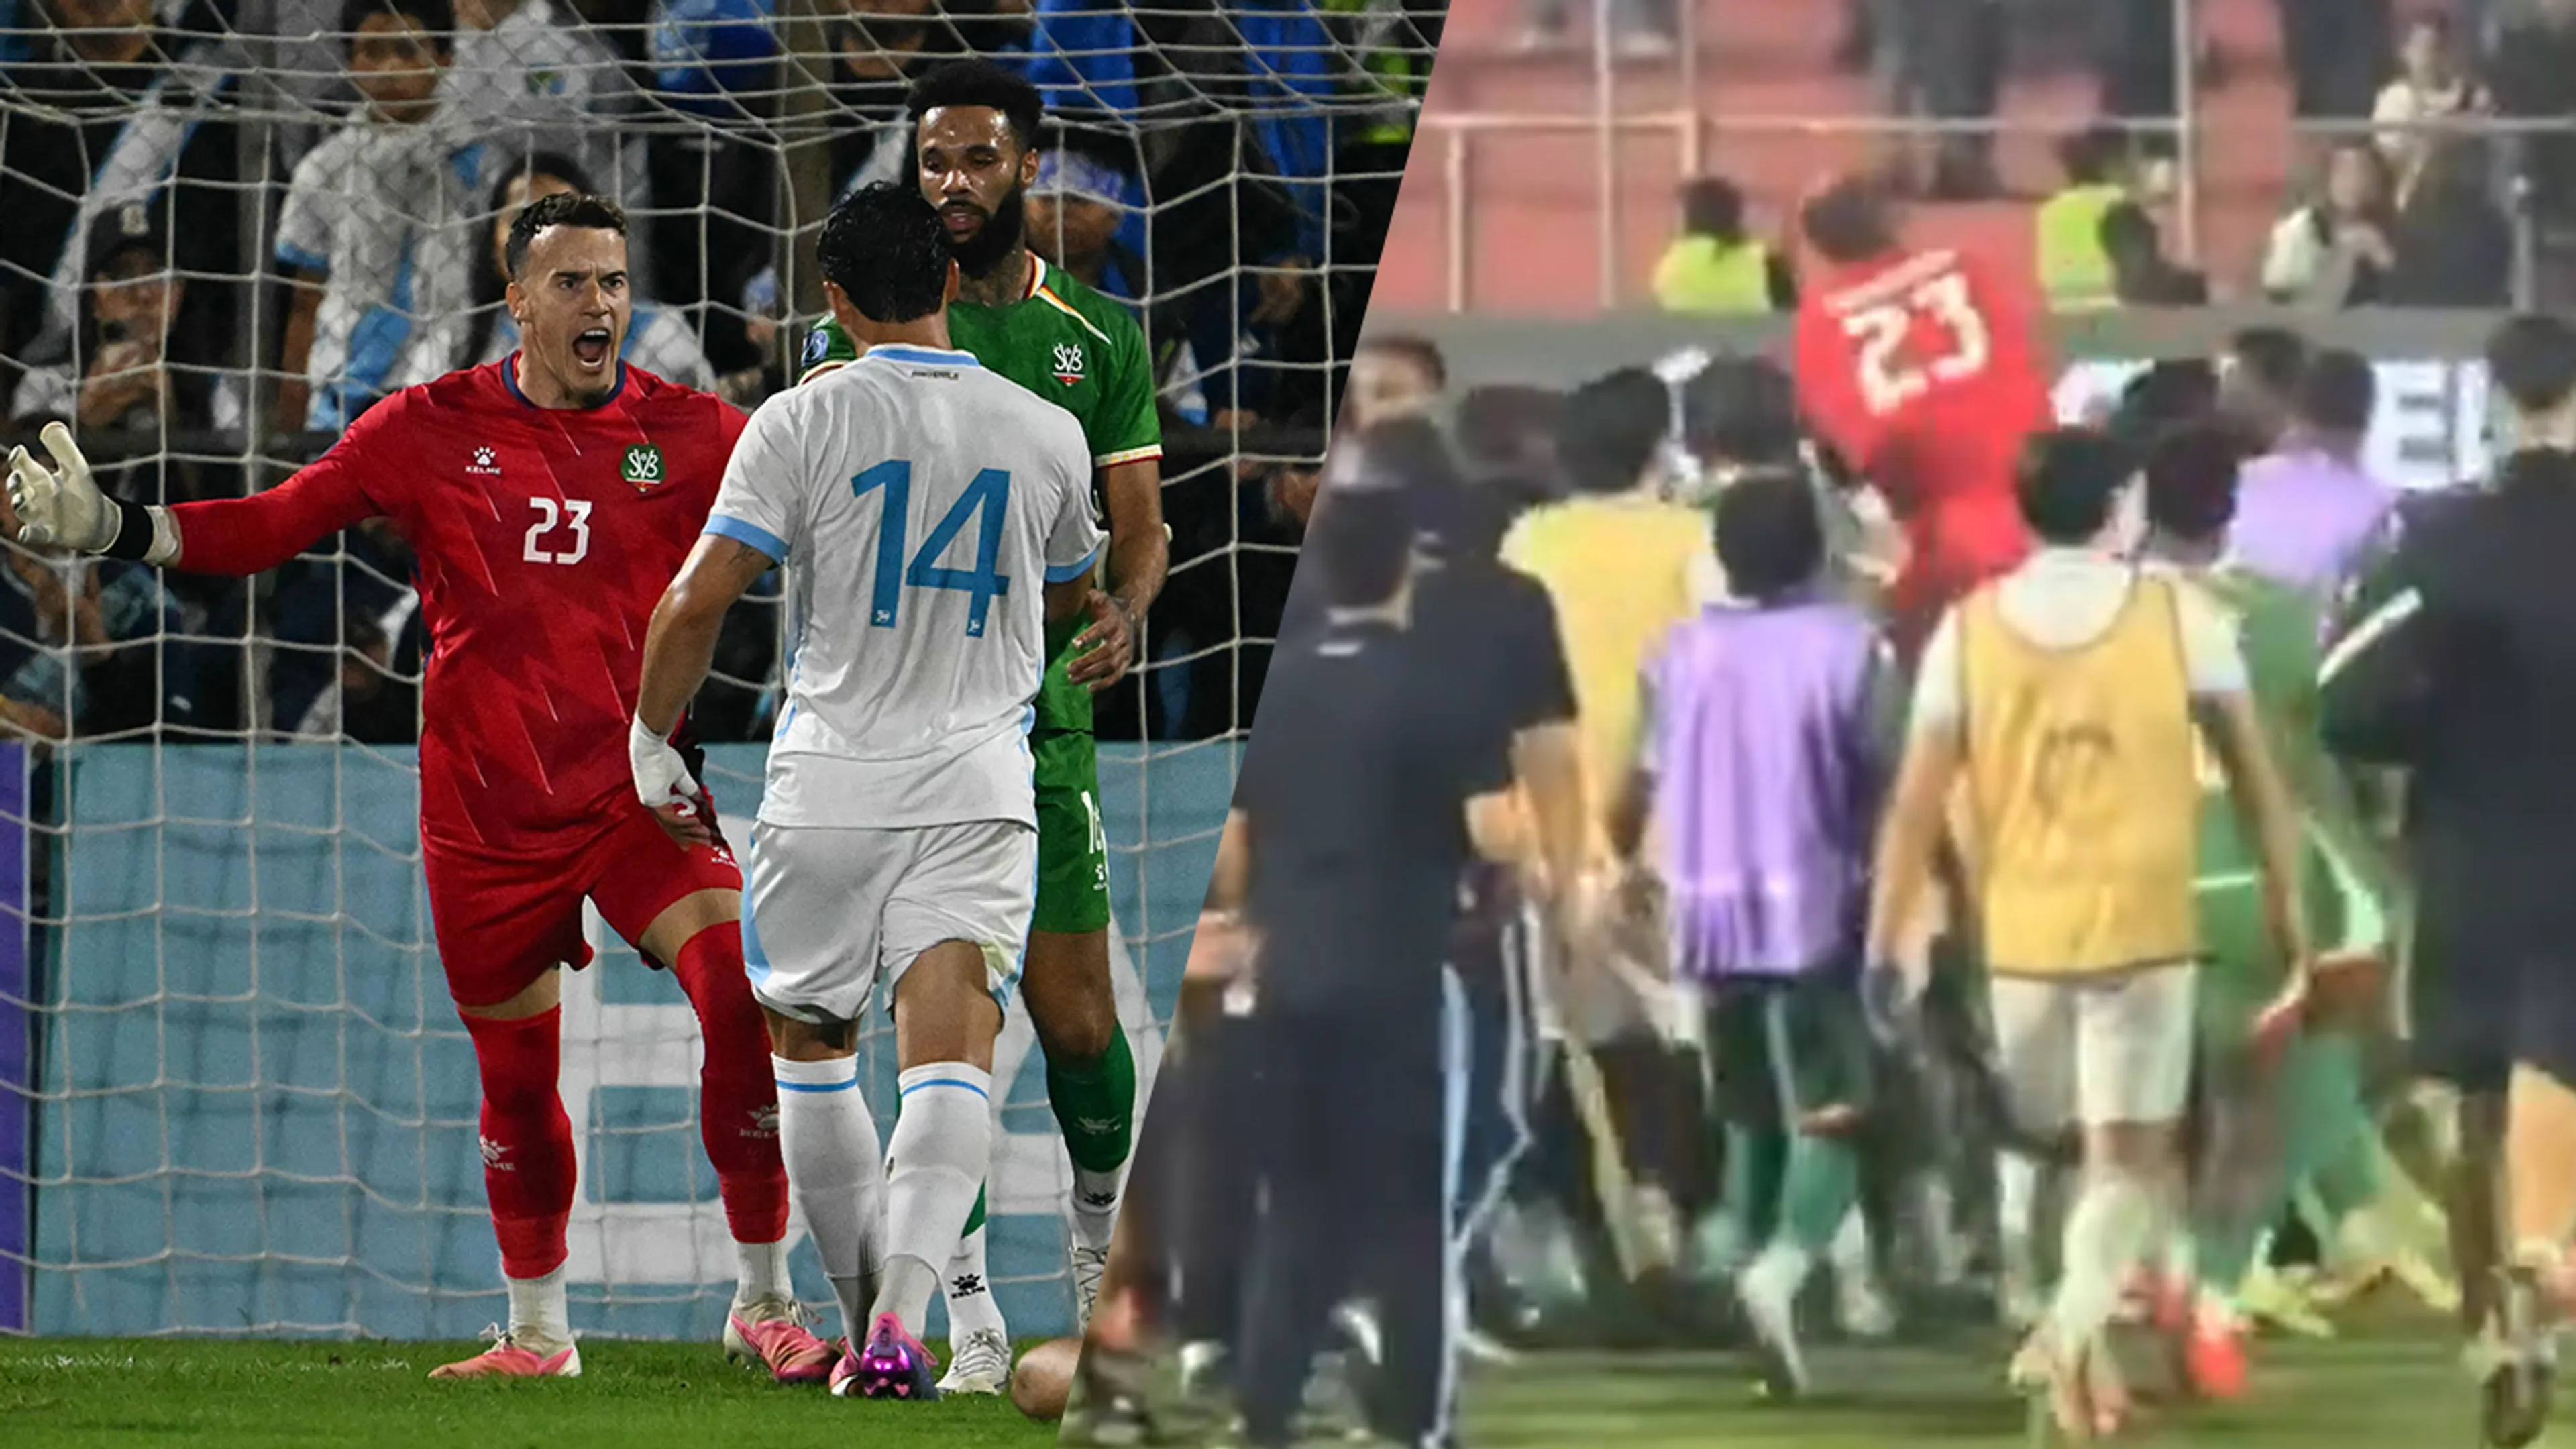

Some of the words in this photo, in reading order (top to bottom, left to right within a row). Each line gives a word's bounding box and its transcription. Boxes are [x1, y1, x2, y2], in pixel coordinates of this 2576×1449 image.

[1841, 271, 1990, 416] 23
[523, 497, 592, 564] 23
[851, 459, 1011, 638] 14
